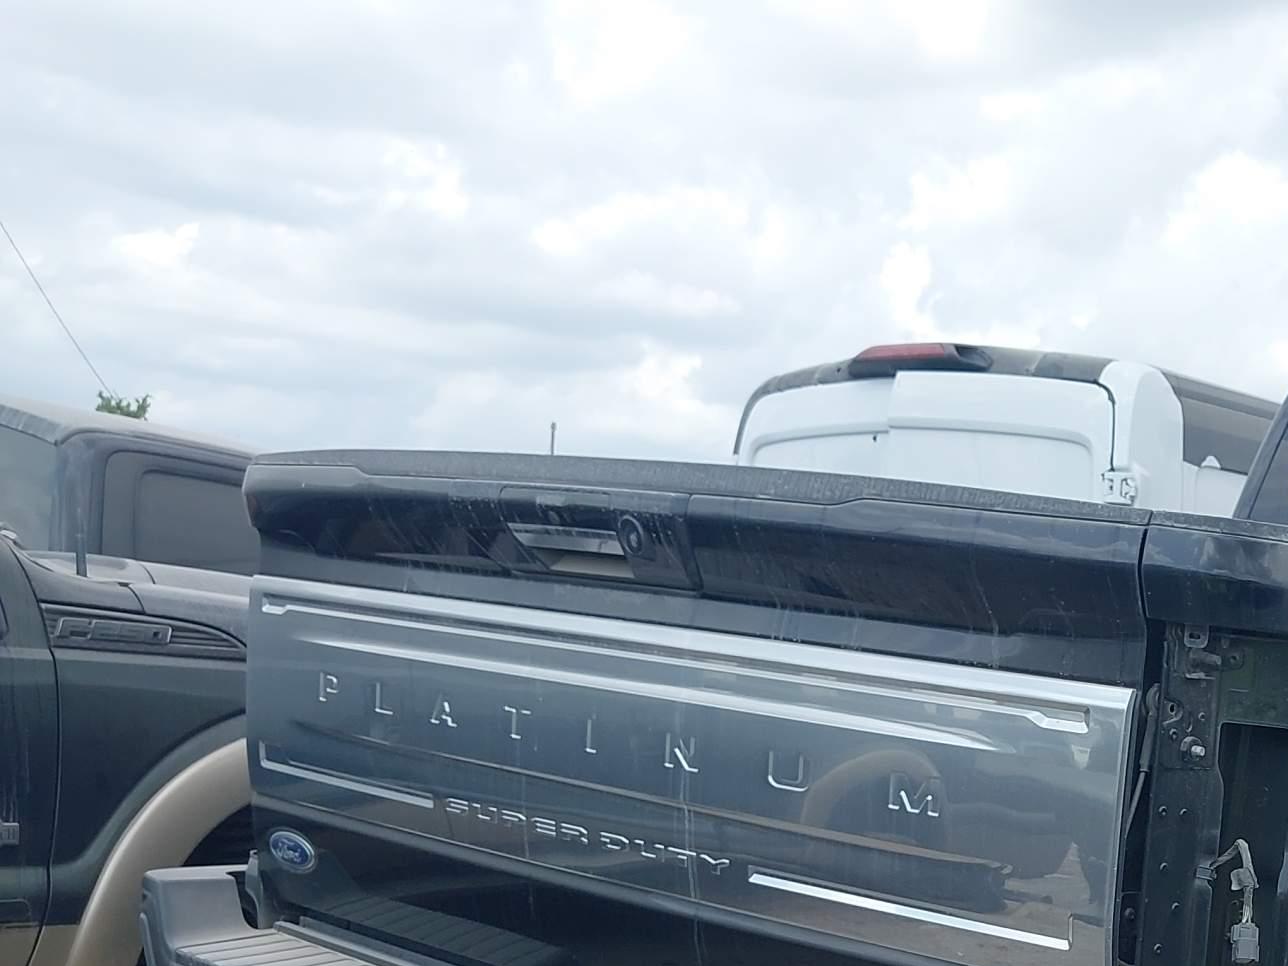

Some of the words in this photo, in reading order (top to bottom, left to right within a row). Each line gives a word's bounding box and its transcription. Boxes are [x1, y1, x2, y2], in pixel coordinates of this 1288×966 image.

[318, 671, 941, 818] PLATINUM
[444, 796, 590, 846] SUPER
[599, 830, 731, 876] DUTY
